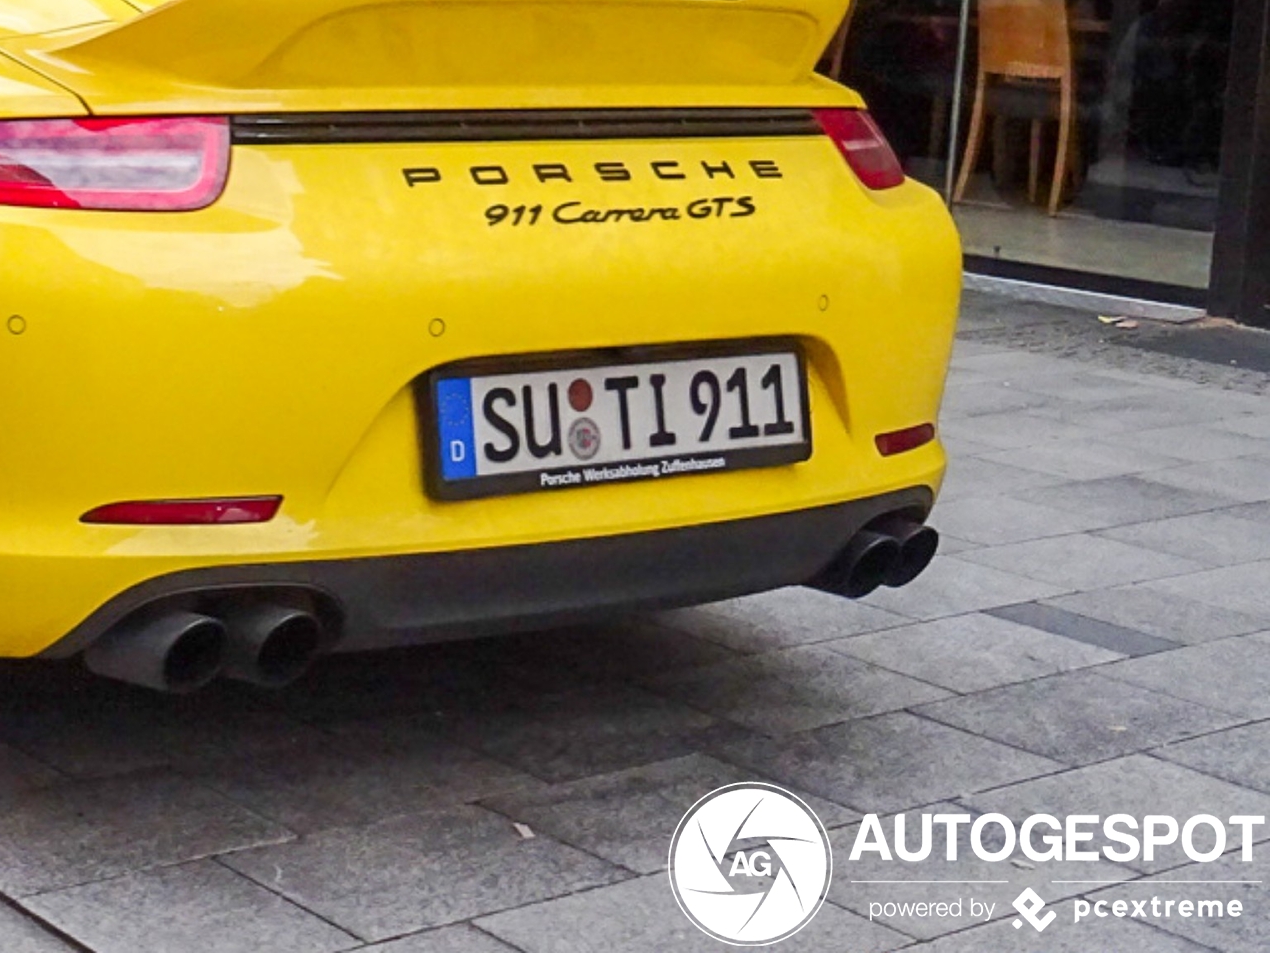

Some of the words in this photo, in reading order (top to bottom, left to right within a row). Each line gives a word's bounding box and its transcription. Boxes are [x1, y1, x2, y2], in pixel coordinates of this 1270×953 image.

[402, 160, 783, 187] PORSCHE
[485, 204, 543, 226] 911
[552, 201, 682, 224] Carrera
[686, 196, 755, 218] GTS
[482, 382, 563, 463] SU
[604, 373, 676, 450] TI
[689, 364, 794, 442] 911
[450, 440, 466, 463] D
[540, 471, 581, 487] Porsche
[583, 463, 660, 483] Werksabholung
[661, 456, 726, 475] Zuffenhausen
